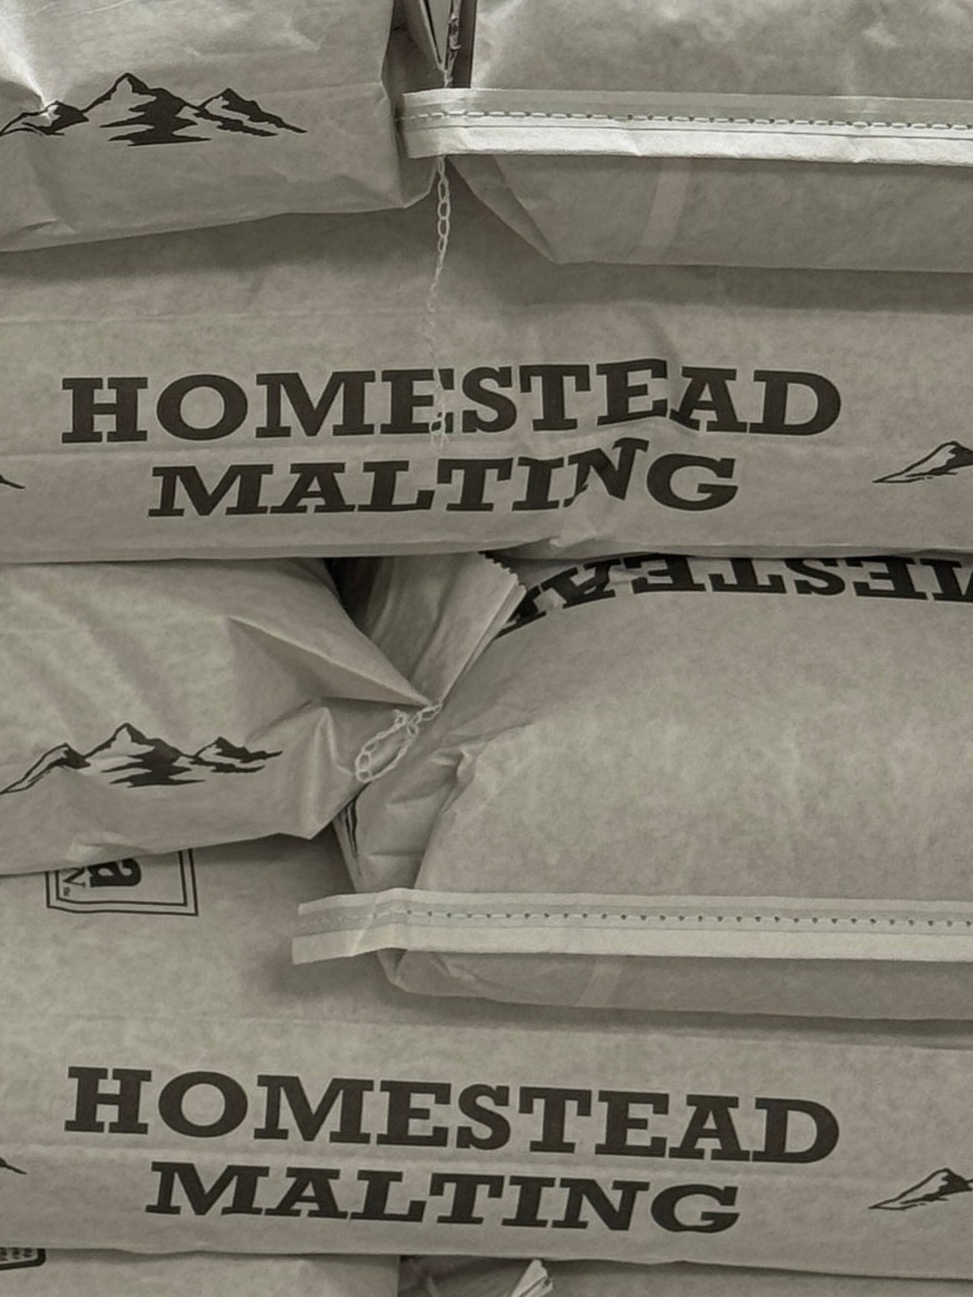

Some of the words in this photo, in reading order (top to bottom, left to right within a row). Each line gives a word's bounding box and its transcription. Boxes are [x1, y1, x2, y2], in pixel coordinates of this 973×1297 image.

[61, 358, 843, 444] HOMESTEAD
[148, 437, 739, 518] MALTING
[62, 1065, 840, 1165] HOMESTEAD
[146, 1160, 740, 1233] MALTING
